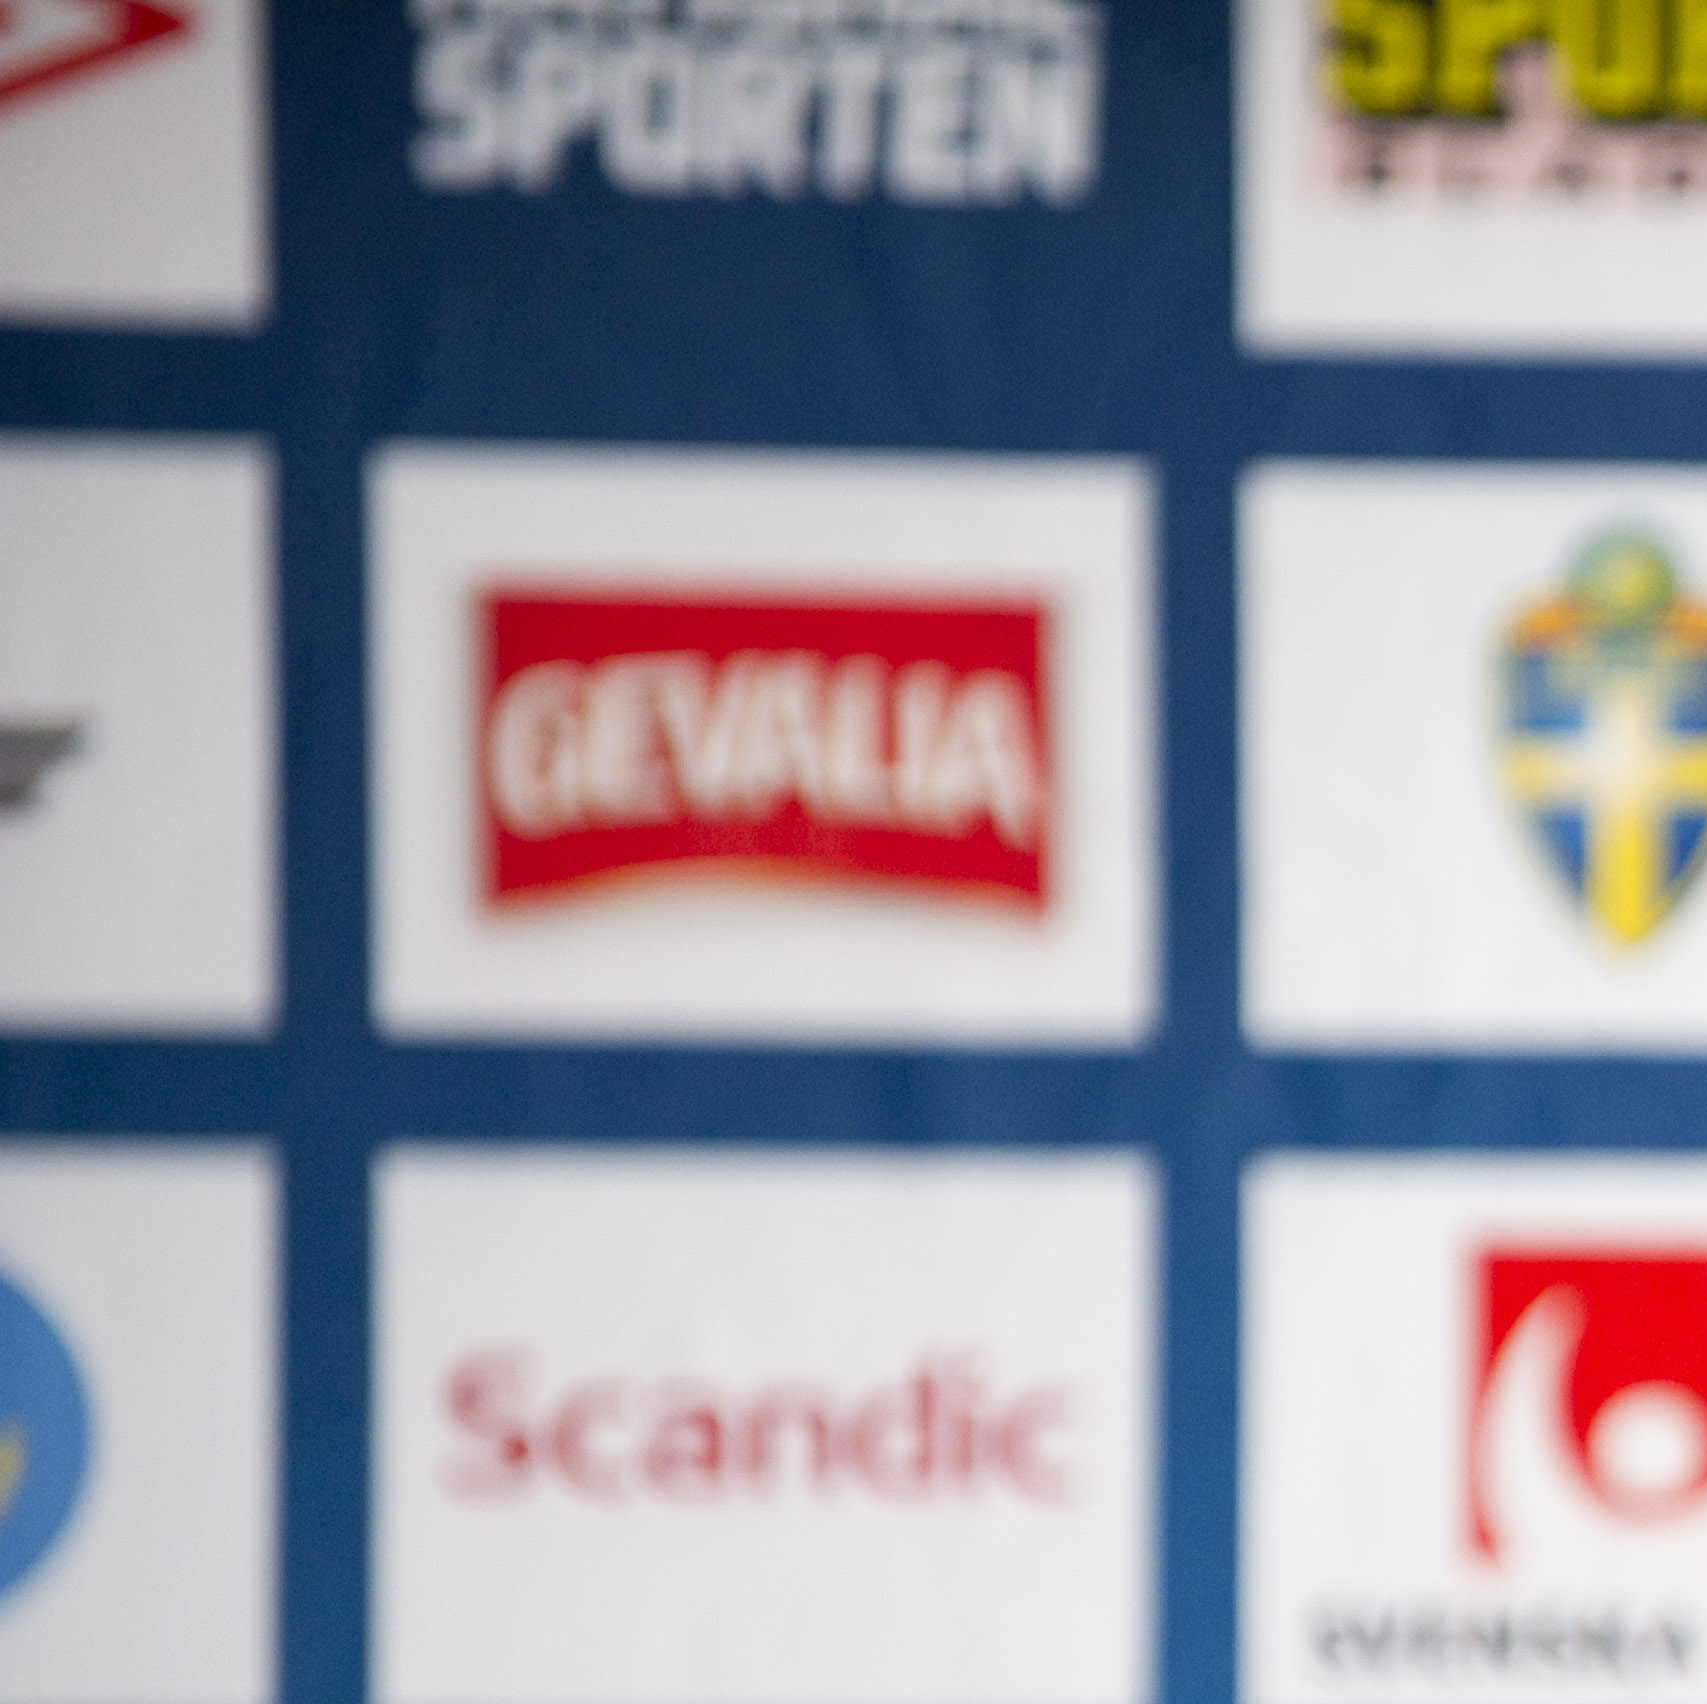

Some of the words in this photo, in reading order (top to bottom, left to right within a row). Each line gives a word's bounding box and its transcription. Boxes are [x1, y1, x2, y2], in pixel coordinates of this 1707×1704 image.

[410, 38, 1105, 207] SPORTEN
[488, 650, 1042, 847] GEVALIA
[440, 1345, 1085, 1507] Scandic
